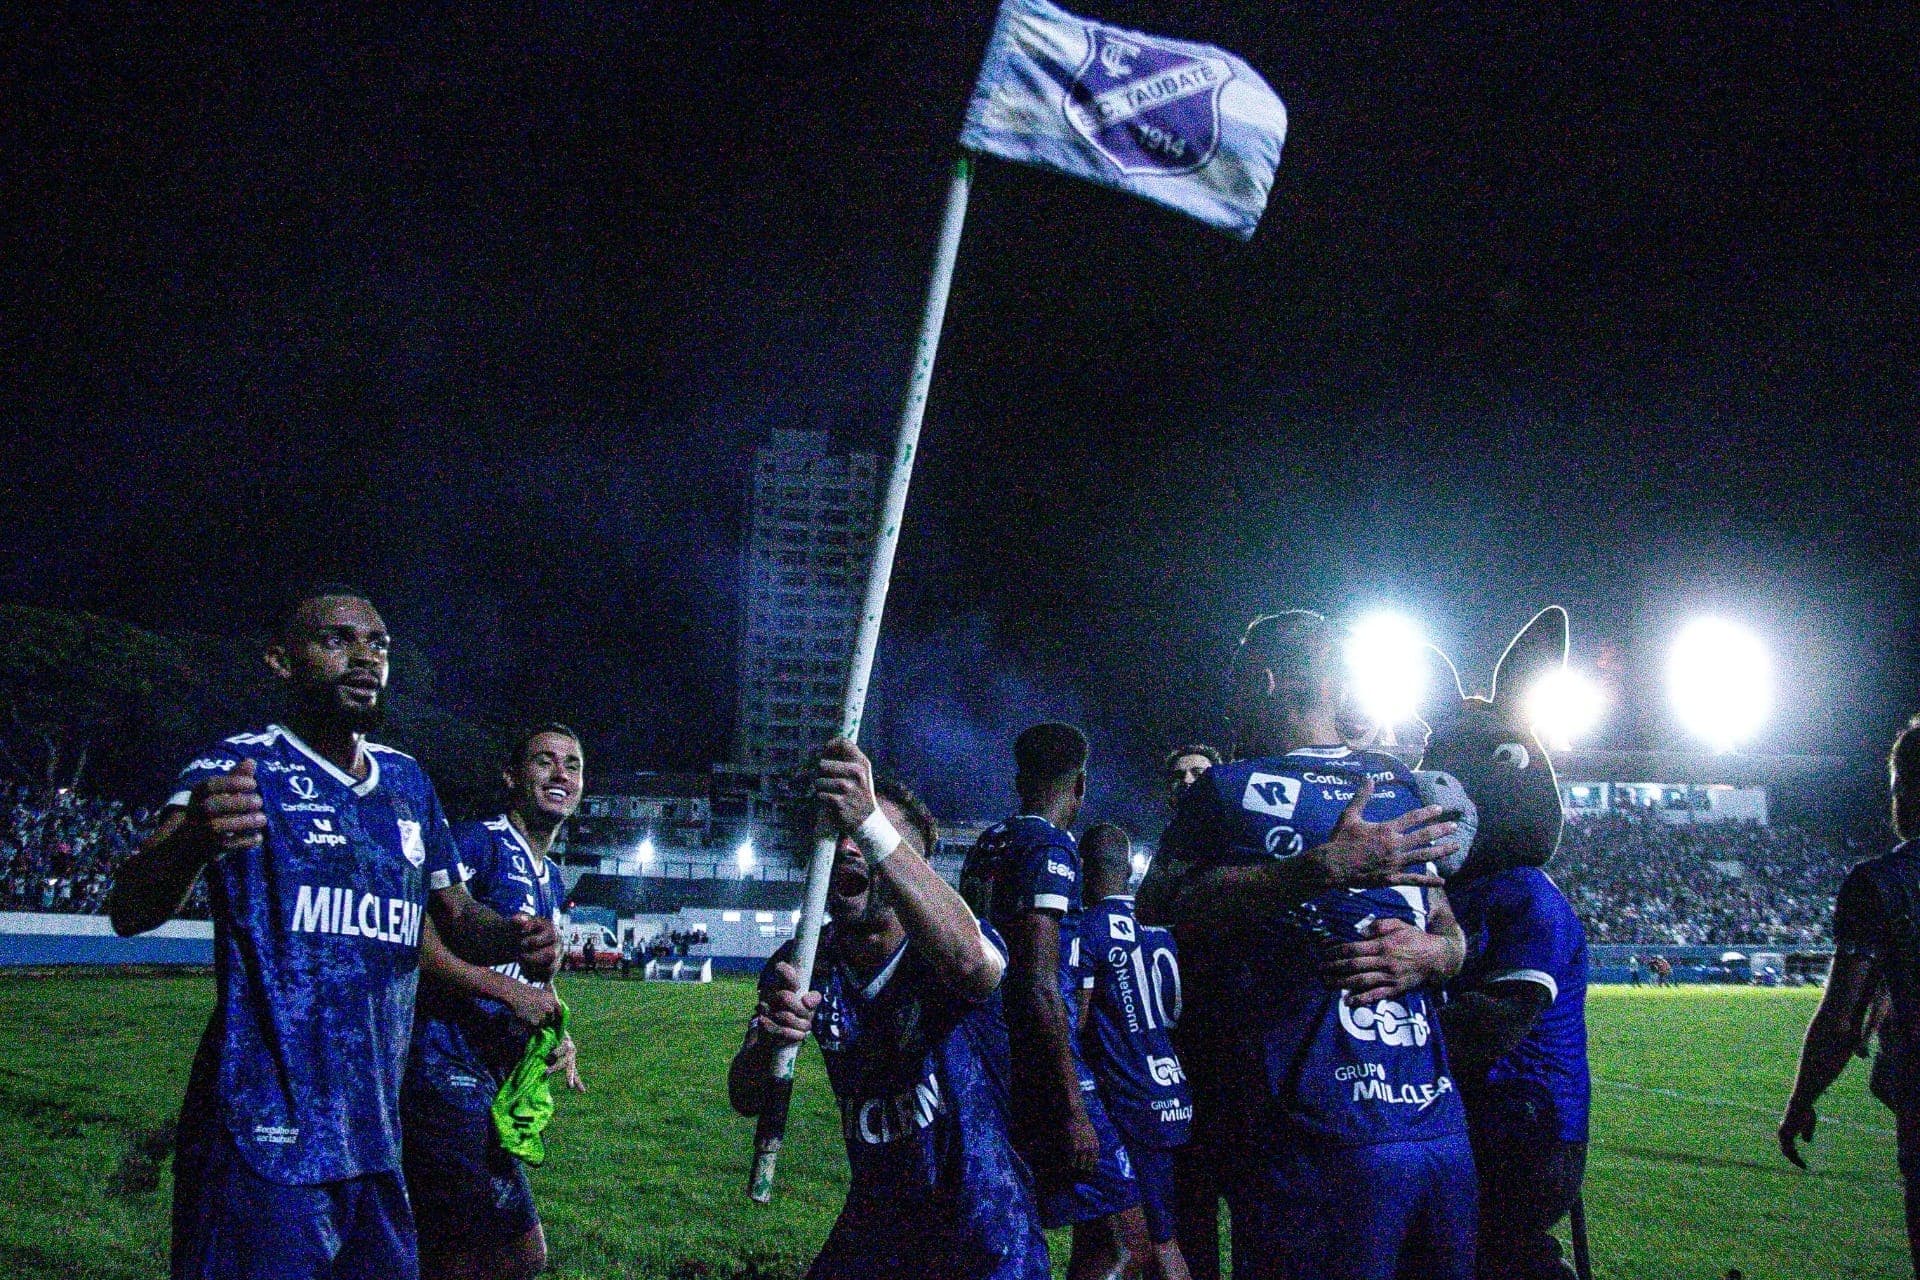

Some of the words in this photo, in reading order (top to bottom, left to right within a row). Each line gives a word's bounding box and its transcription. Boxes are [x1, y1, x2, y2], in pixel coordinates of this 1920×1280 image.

[1138, 123, 1186, 157] 1914
[291, 885, 422, 947] MILCLEAN
[1130, 944, 1183, 1029] 10
